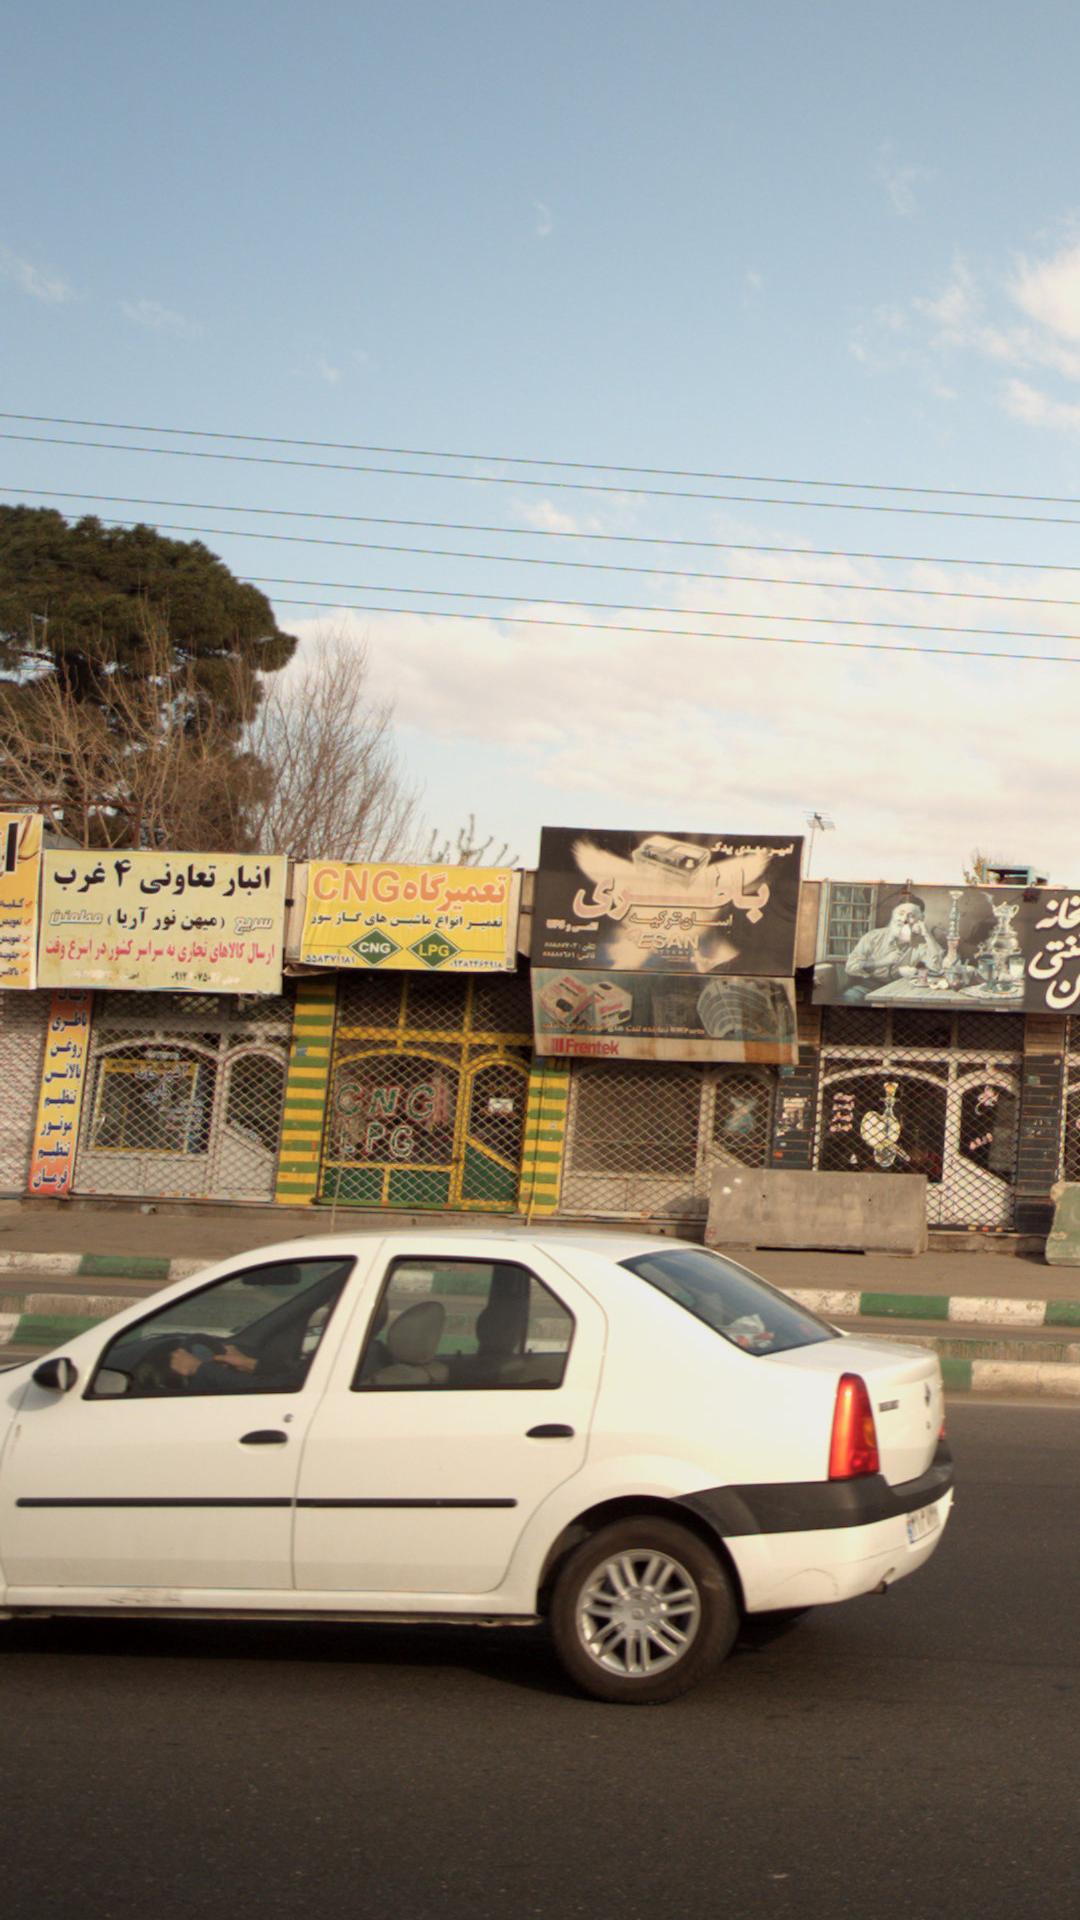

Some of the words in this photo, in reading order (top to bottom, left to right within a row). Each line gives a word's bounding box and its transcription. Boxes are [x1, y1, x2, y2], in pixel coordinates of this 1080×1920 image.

[53, 861, 106, 892] غرب
[114, 859, 132, 887] ۴
[140, 863, 217, 895] تعاونی
[221, 864, 271, 896] انبار
[312, 868, 401, 903] CNG
[402, 872, 507, 912] تعمیرگاه
[152, 910, 177, 931] نور
[364, 913, 388, 926] های
[390, 914, 431, 927] ماشین
[435, 915, 464, 929] انواع
[466, 916, 503, 930] تعمیر
[135, 939, 163, 962] سراسر
[358, 941, 391, 954] CNG
[418, 944, 449, 957] LPG
[638, 934, 700, 951] ESAN
[248, 943, 275, 965] ارسال
[52, 1010, 87, 1032] باطری
[50, 1037, 82, 1058] روغن
[45, 1063, 81, 1083] بالانس
[44, 1089, 76, 1108] تنظیم
[336, 1082, 436, 1121] CNG
[41, 1115, 72, 1136] موتور
[38, 1141, 70, 1159] تنظیم
[33, 1167, 68, 1189] فرمان
